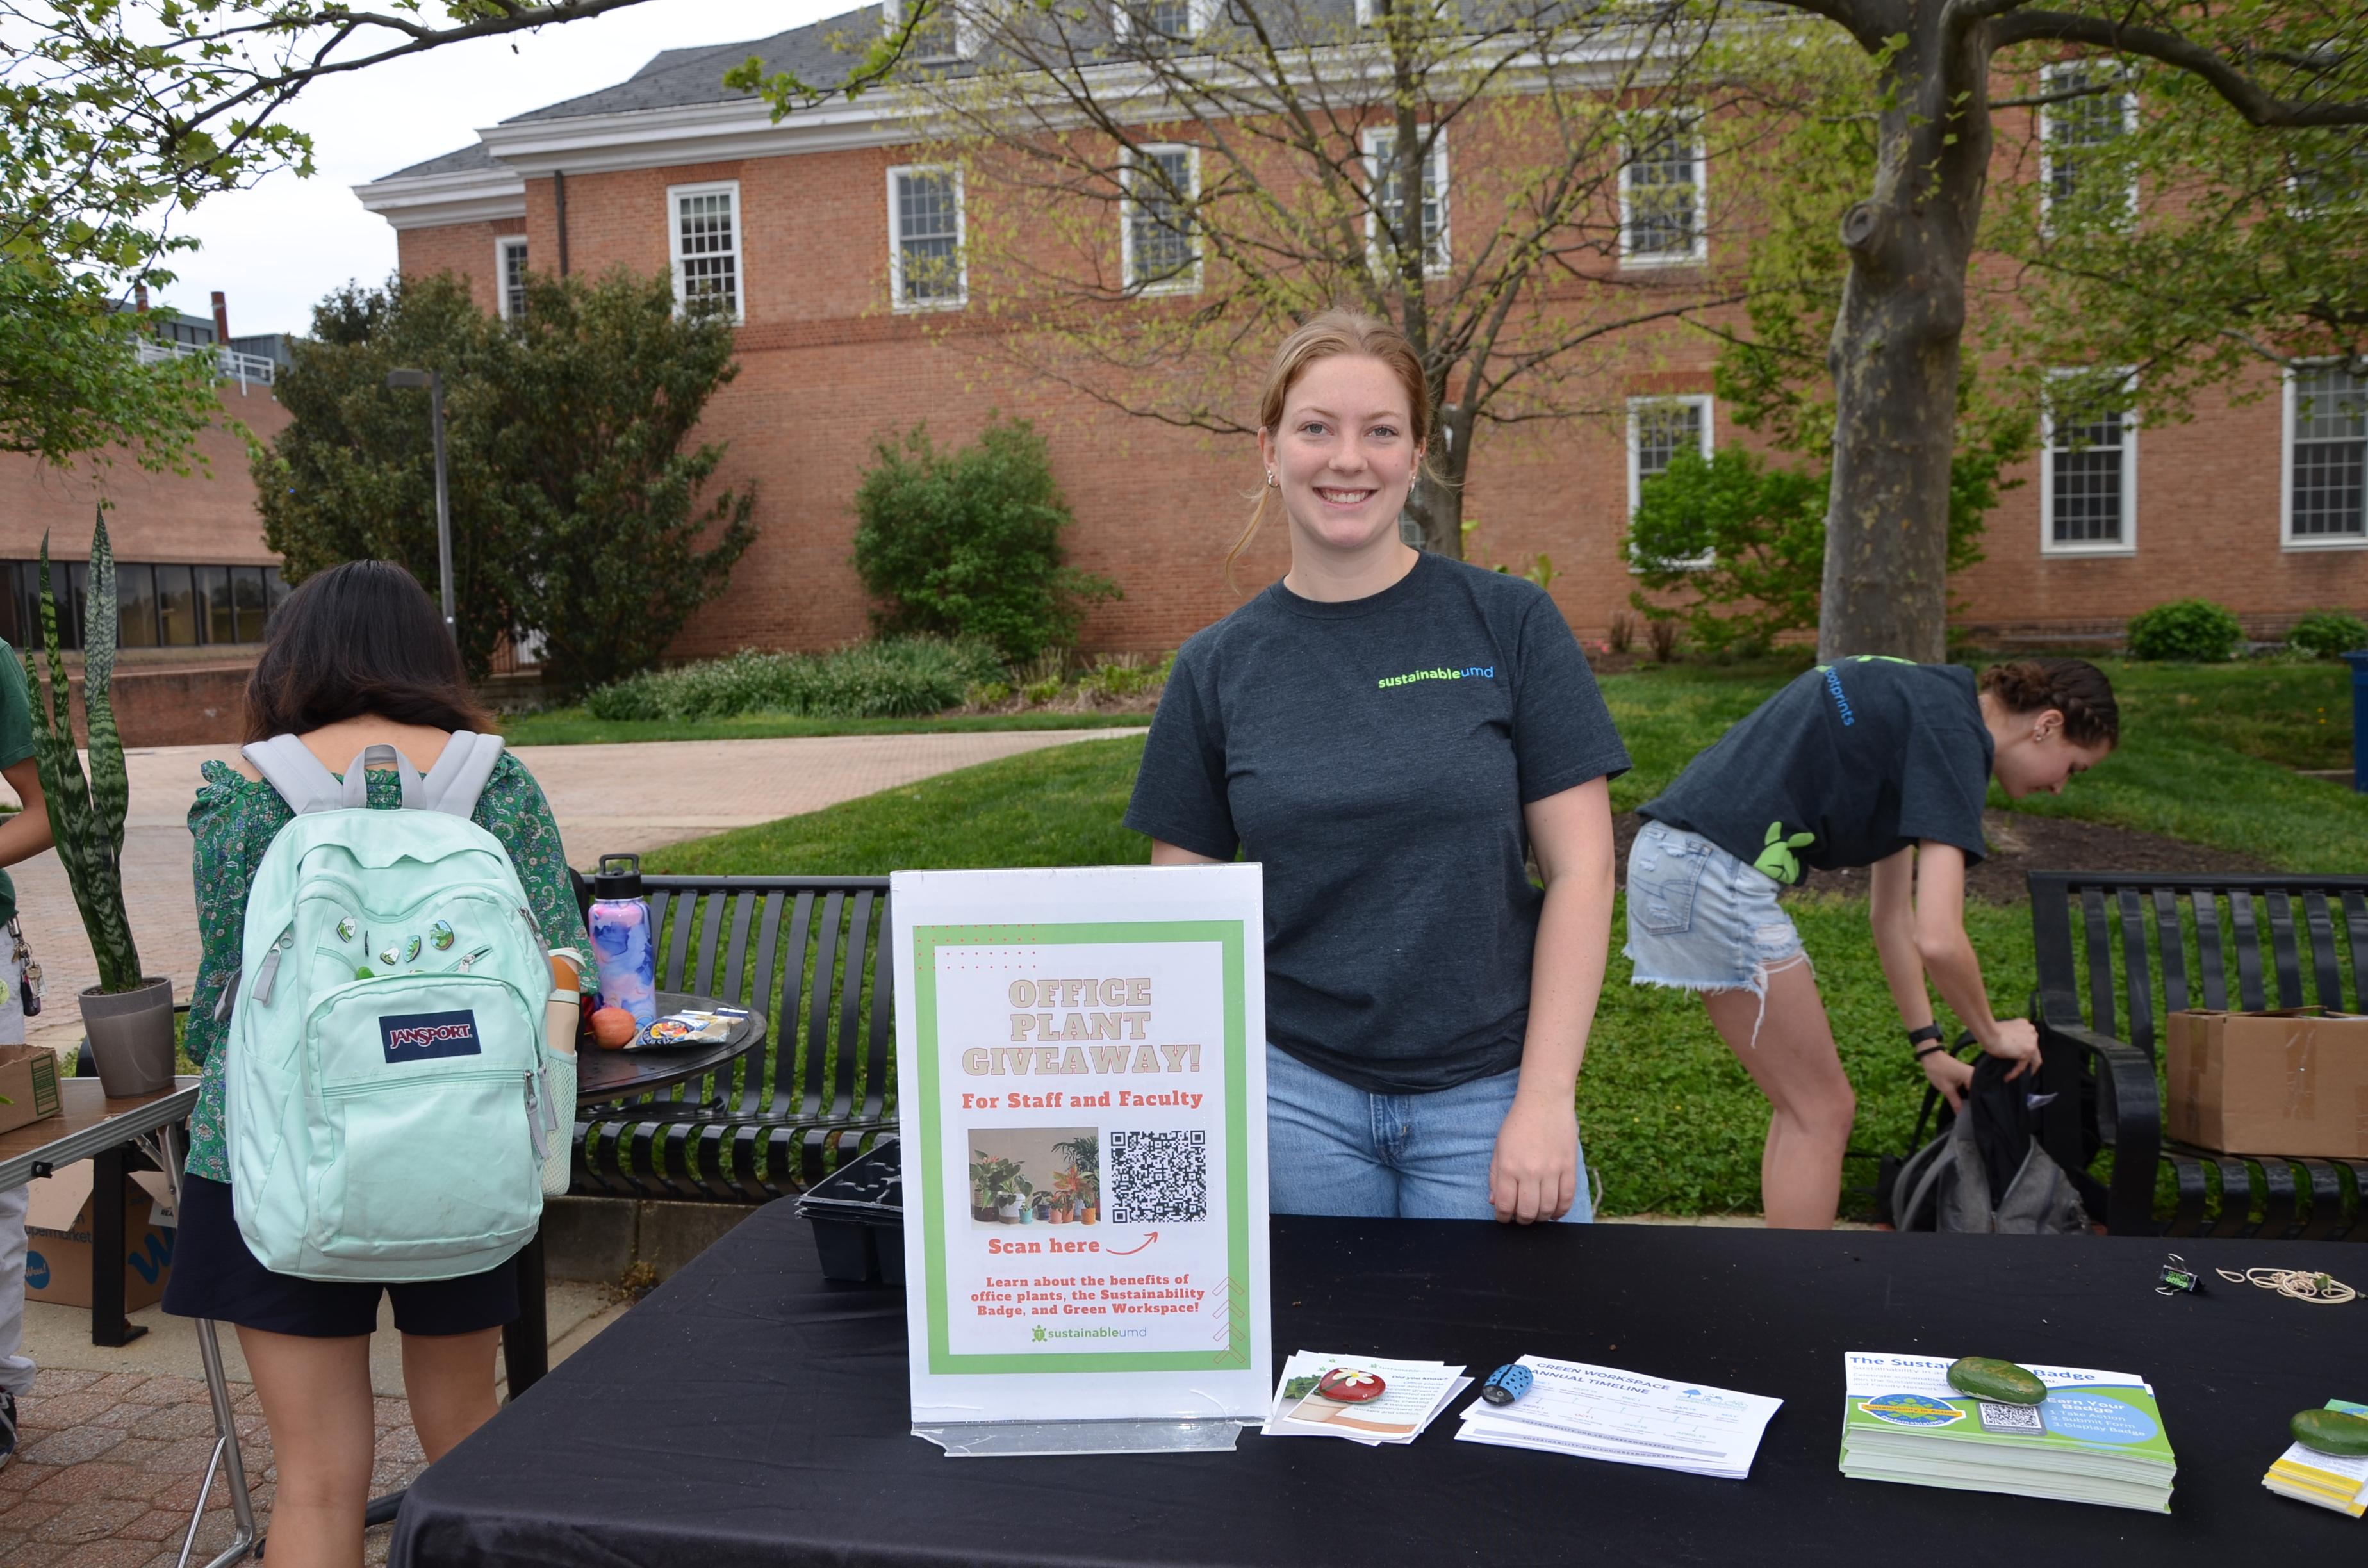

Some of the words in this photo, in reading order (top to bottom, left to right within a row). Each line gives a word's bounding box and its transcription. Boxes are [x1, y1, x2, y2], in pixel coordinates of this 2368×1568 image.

[1378, 666, 1494, 689] sustainableumd
[1008, 977, 1151, 1008] OFFICE
[1010, 1011, 1151, 1041] PLANT
[390, 1024, 471, 1049] JANSPORT
[962, 1044, 1201, 1076] GIVEAWAY!
[962, 1093, 999, 1109] For
[1008, 1091, 1062, 1109] Staff
[1071, 1091, 1110, 1107] and
[1119, 1090, 1203, 1109] Faculty
[988, 1239, 1041, 1254] Scan
[1049, 1238, 1100, 1254] here
[986, 1277, 1029, 1287] Learn
[1034, 1277, 1076, 1287] about
[1081, 1275, 1105, 1286] the
[1110, 1275, 1170, 1286] benefits
[1174, 1274, 1189, 1284] of
[2166, 1277, 2189, 1288] office
[2168, 1271, 2189, 1281] green
[971, 1291, 1012, 1302] office
[1017, 1291, 1066, 1303] plants,
[1071, 1290, 1096, 1300] the
[1100, 1288, 1205, 1300] Sustainability
[977, 1305, 1026, 1318] Badge,
[1032, 1305, 1058, 1315] and
[1063, 1303, 1106, 1314] Green
[1112, 1302, 1199, 1315] Workspace!
[1048, 1327, 1147, 1339] sustainableumd
[1536, 1362, 1582, 1374] GREEN
[1585, 1369, 1671, 1391] WORKSPACE
[1850, 1357, 1884, 1365] The
[2034, 1369, 2096, 1381] Badge
[1531, 1369, 1584, 1384] ANNUAL
[1588, 1378, 1651, 1395] TIMELINE
[2046, 1397, 2083, 1405] Earn
[2087, 1400, 2125, 1410] Your
[2062, 1403, 2114, 1414] Badge
[2089, 1413, 2126, 1422] Action
[2106, 1421, 2135, 1429] Form
[2109, 1427, 2146, 1437] Badge
